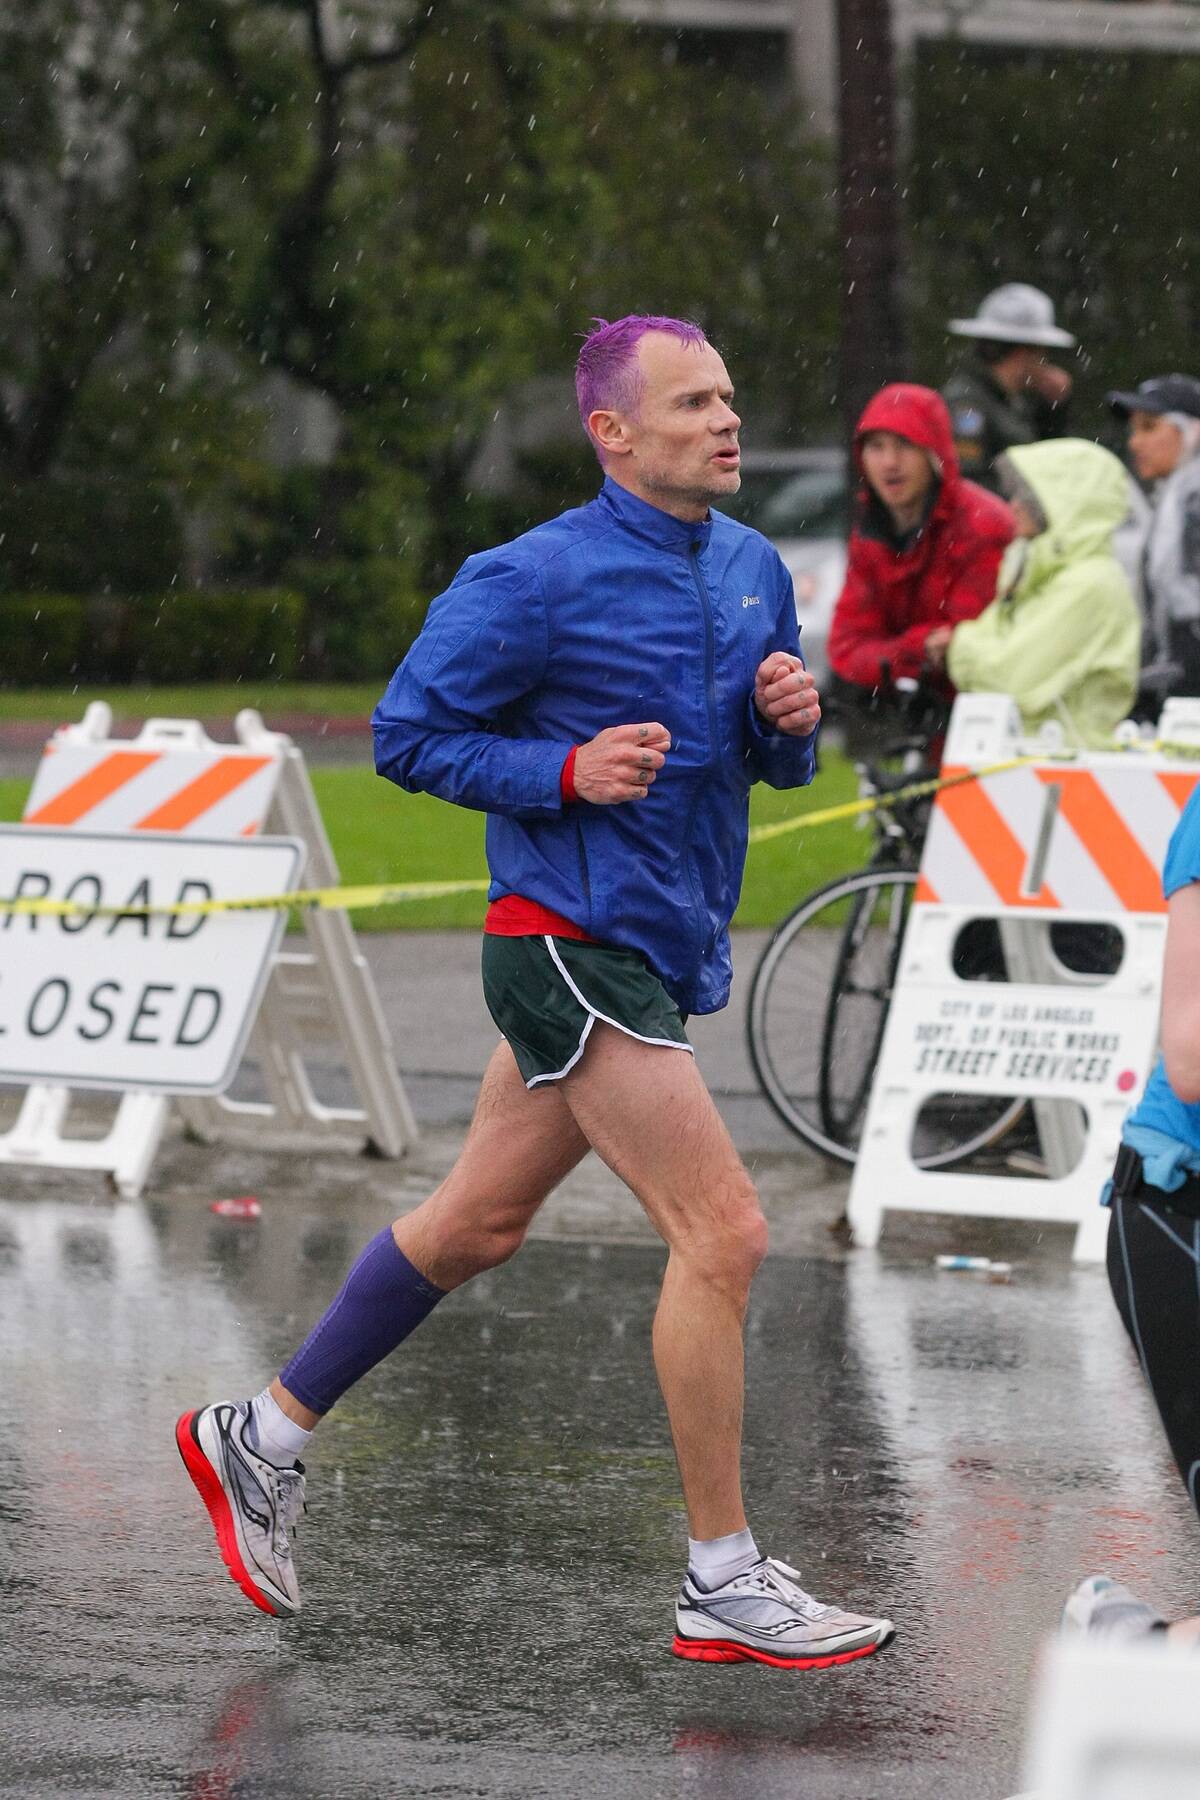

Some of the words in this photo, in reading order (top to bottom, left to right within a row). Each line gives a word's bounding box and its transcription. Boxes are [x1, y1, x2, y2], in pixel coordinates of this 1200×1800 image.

[4, 872, 213, 940] ROAD
[0, 978, 223, 1047] OSED
[916, 1049, 998, 1075] STREET
[1006, 1053, 1112, 1083] SERVICES
[998, 1029, 1057, 1048] PUBLIC
[1065, 1032, 1120, 1052] WORKS
